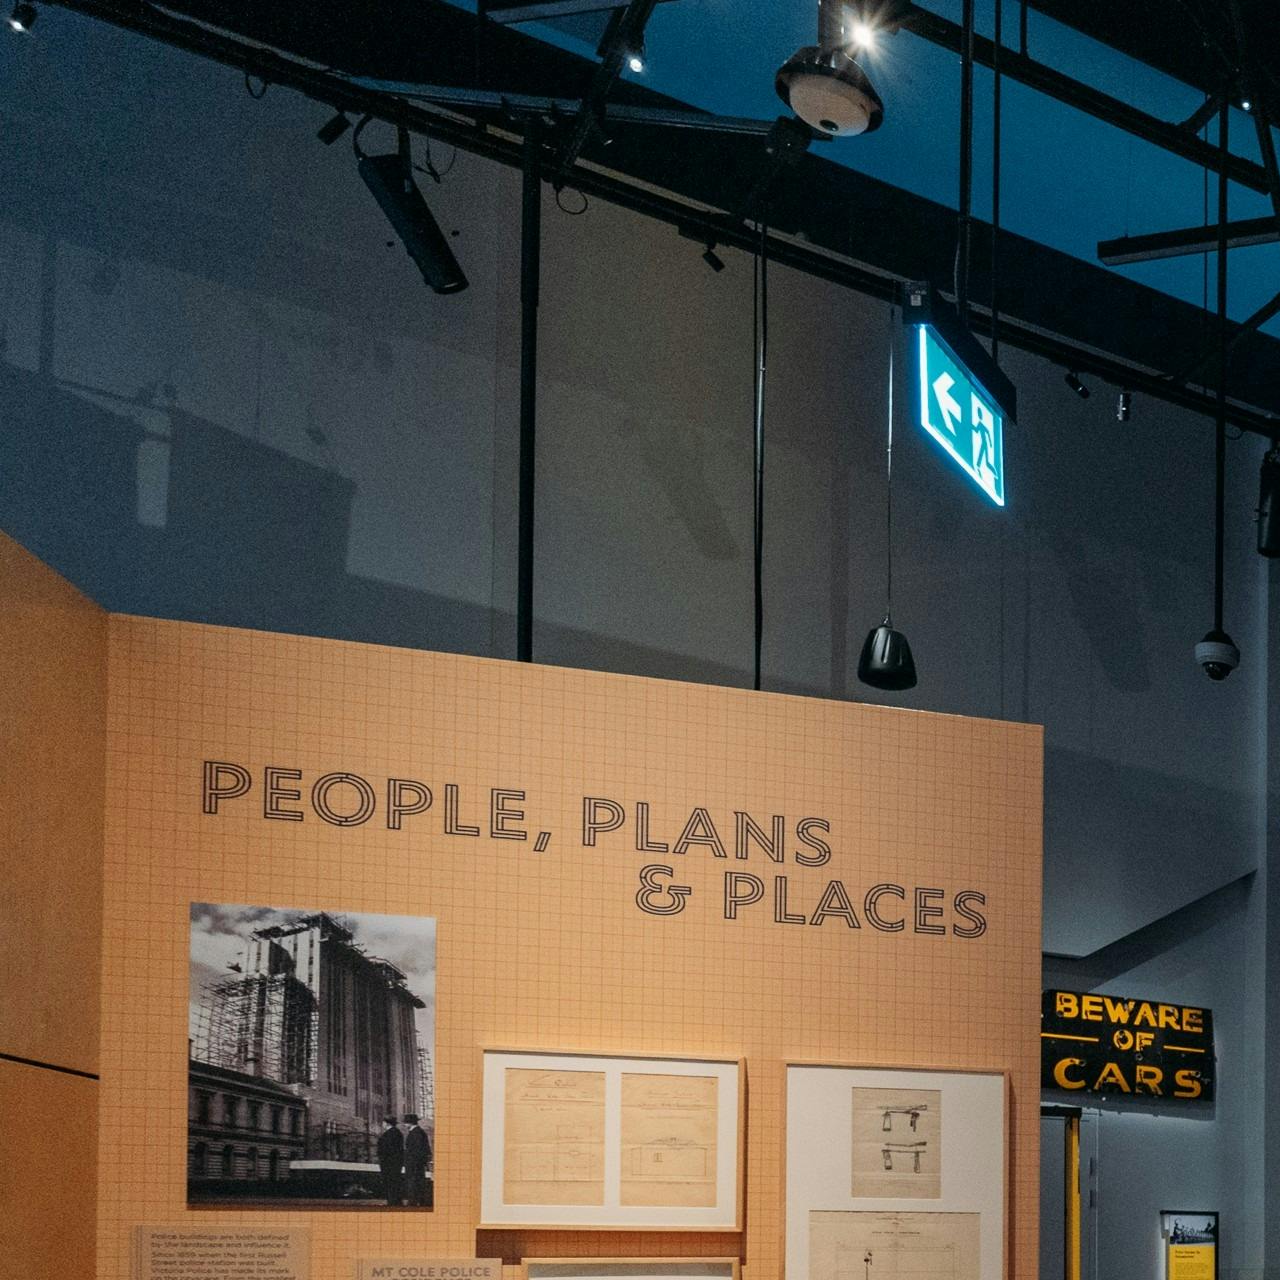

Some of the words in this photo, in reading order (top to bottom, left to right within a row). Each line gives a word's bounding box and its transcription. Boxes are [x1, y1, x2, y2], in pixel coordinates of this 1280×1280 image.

[203, 761, 552, 853] PEOPLE,
[582, 797, 831, 868] PLANS
[636, 864, 692, 916] &
[723, 870, 988, 939] PLACES
[1056, 992, 1203, 1033] BEWARE
[1113, 1030, 1155, 1052] OF
[1053, 1057, 1203, 1098] CARS
[371, 1267, 394, 1277] MT
[398, 1267, 436, 1277] COLE
[440, 1267, 491, 1277] POLICE
